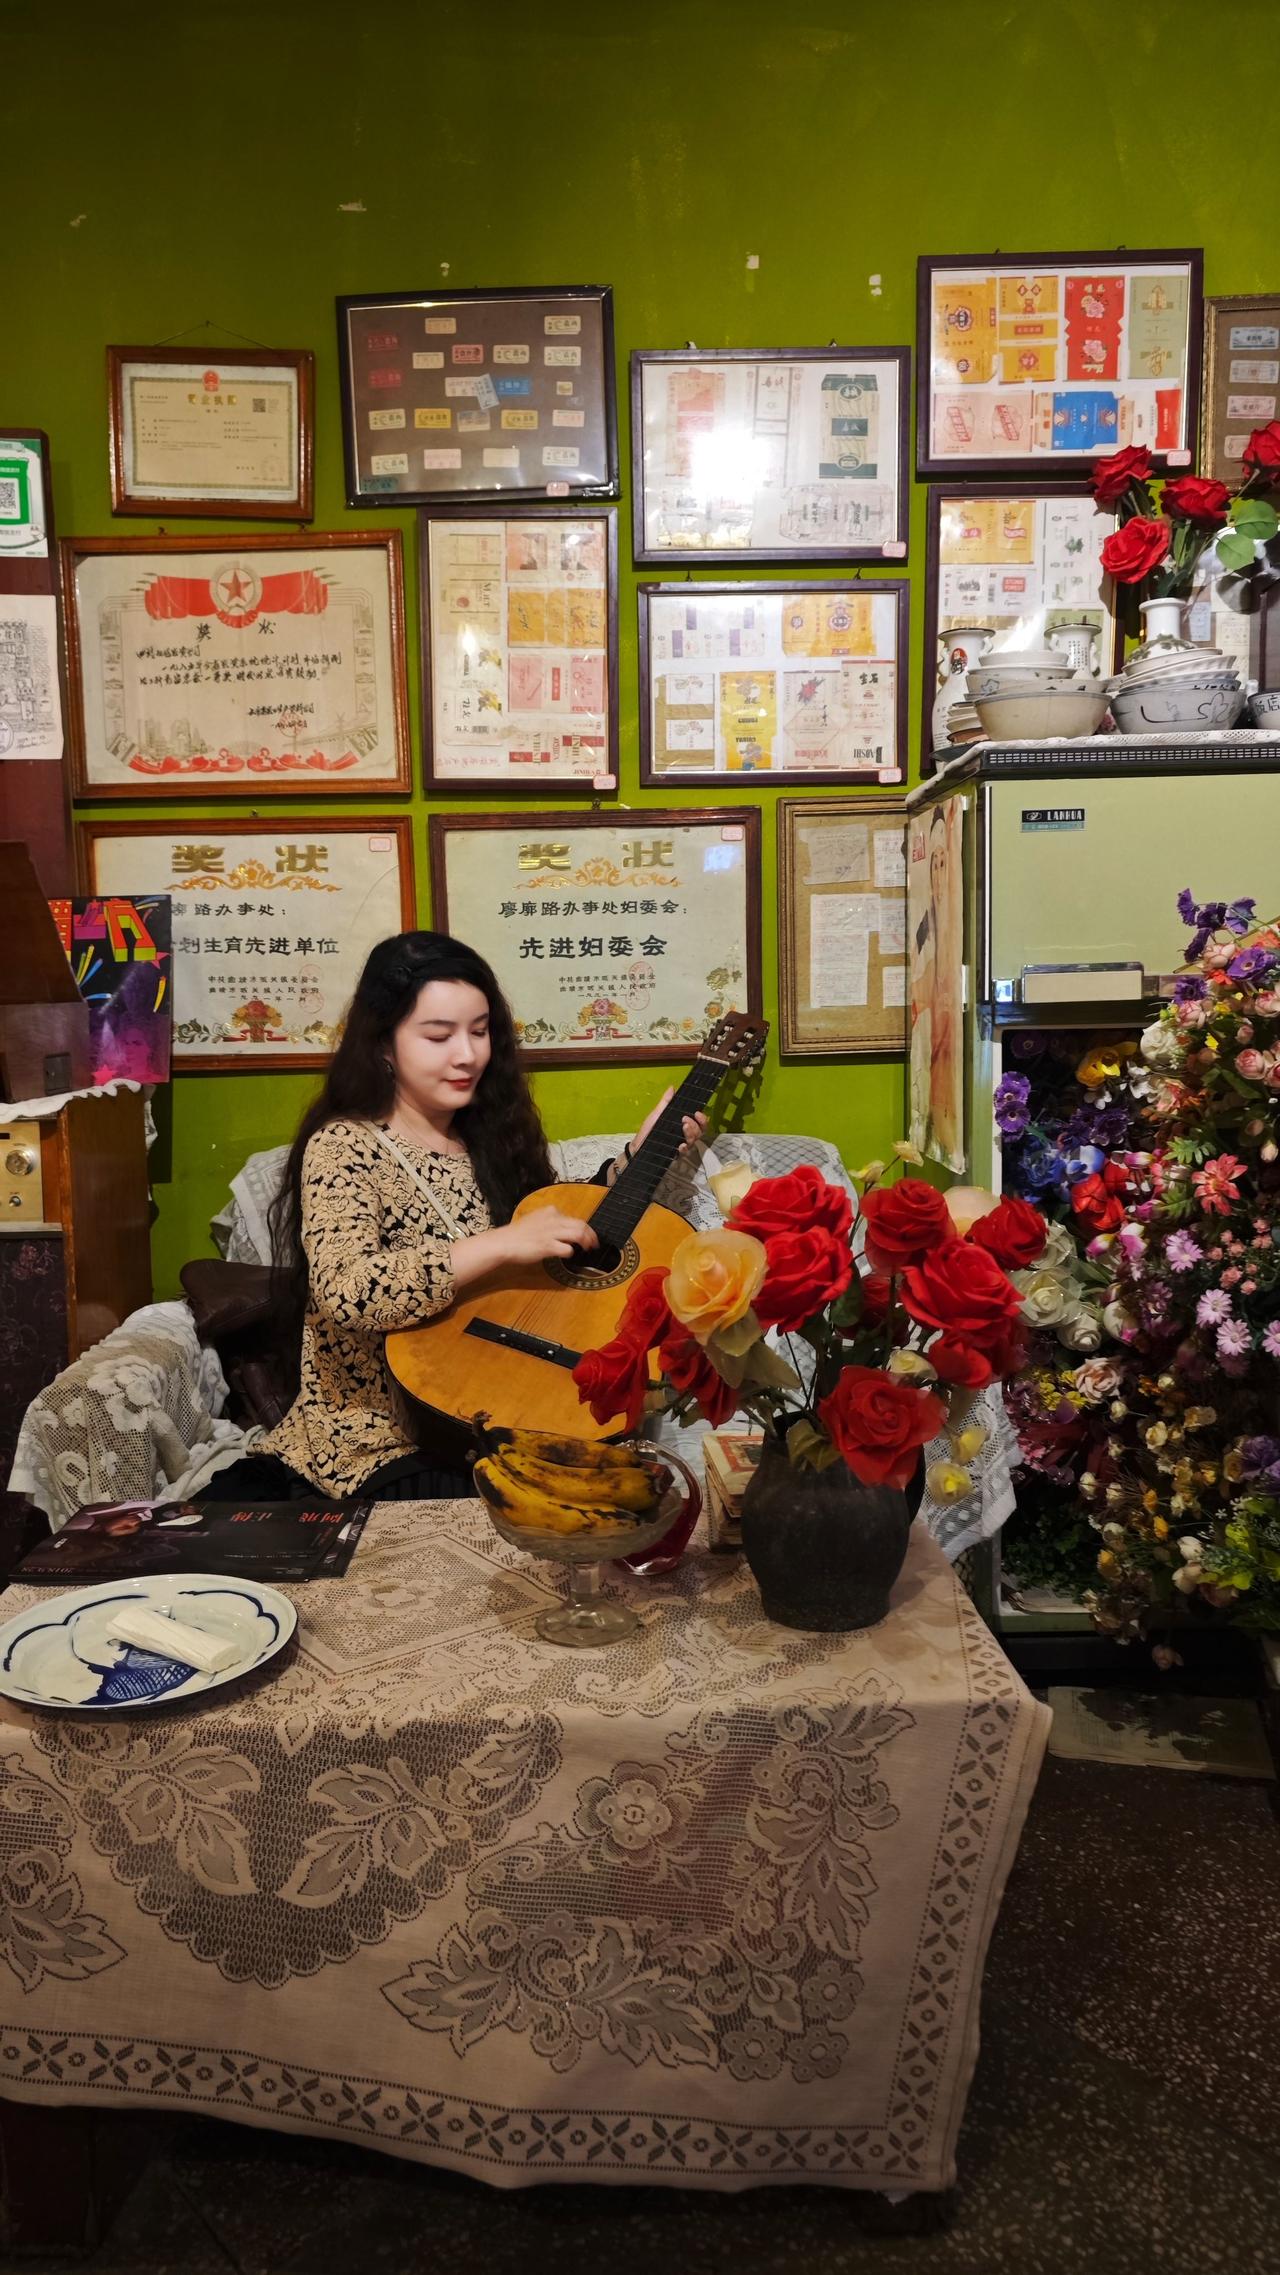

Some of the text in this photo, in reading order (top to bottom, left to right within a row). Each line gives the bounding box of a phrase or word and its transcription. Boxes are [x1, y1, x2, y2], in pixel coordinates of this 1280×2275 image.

[1047, 810, 1082, 821] LANHUA
[172, 845, 328, 873] 奖状
[518, 840, 675, 871] 奖状
[171, 935, 341, 957] 划生育先进单位
[519, 934, 668, 960] 先进妇委会
